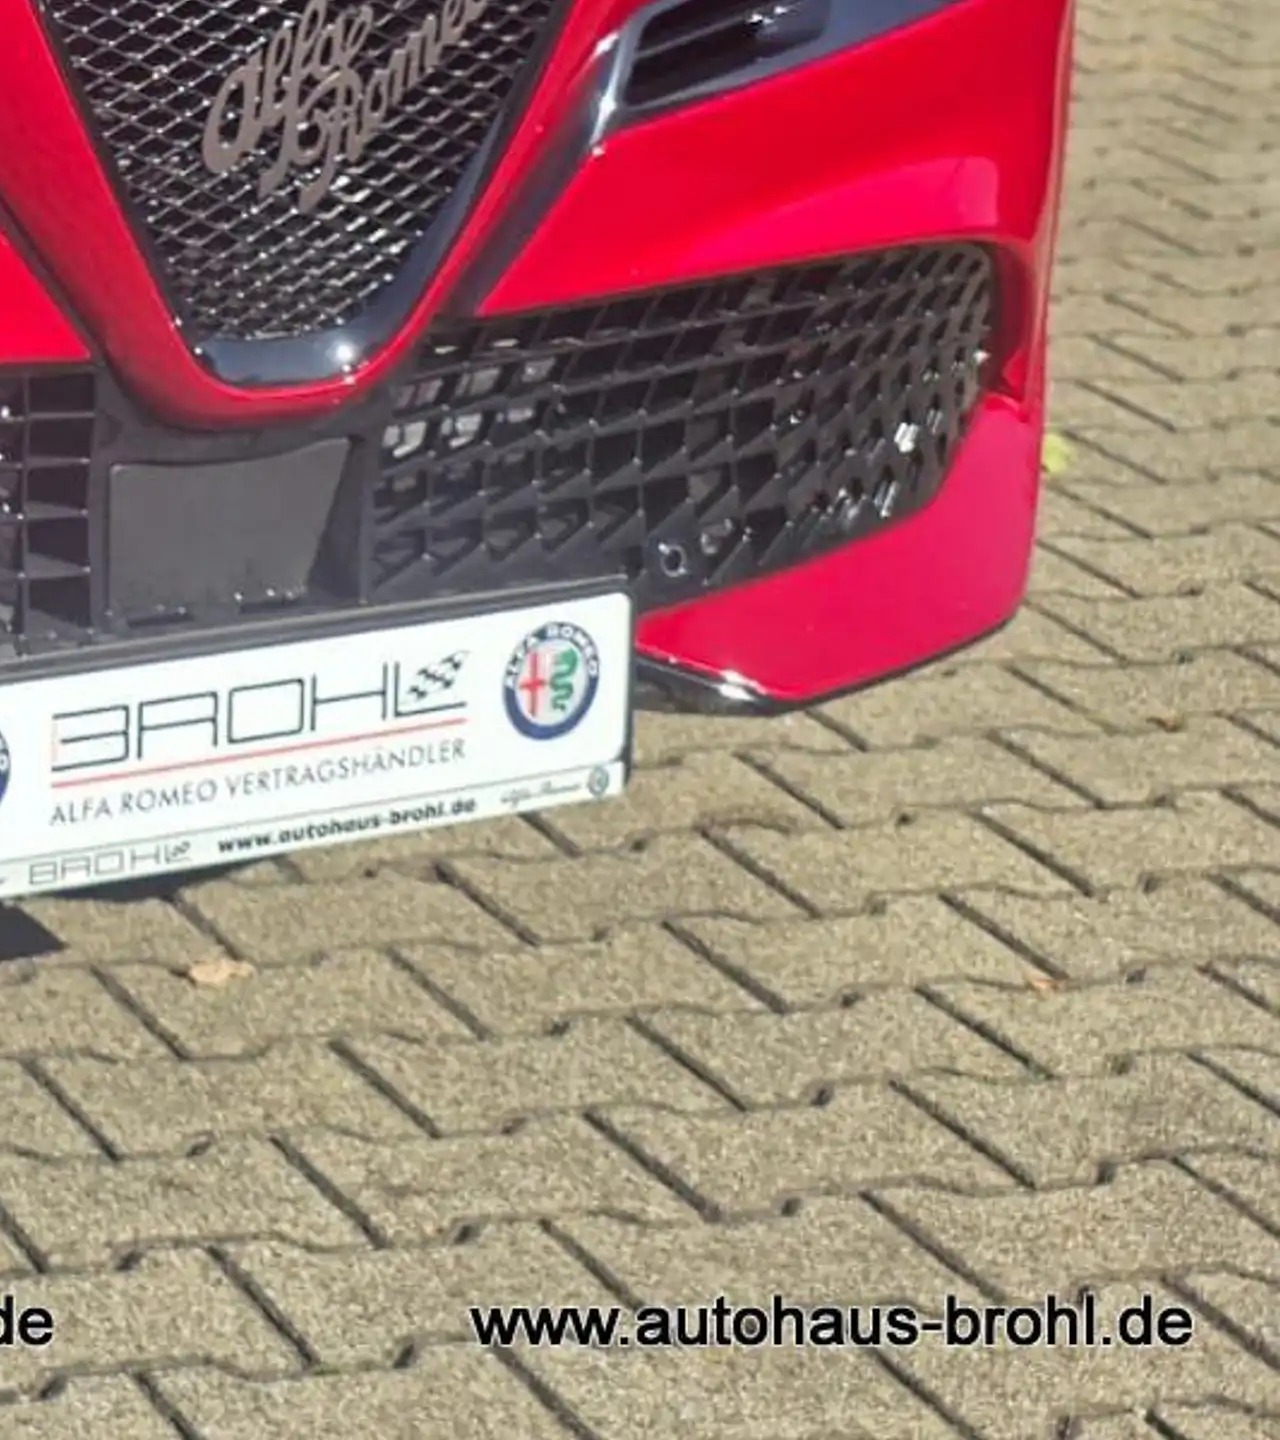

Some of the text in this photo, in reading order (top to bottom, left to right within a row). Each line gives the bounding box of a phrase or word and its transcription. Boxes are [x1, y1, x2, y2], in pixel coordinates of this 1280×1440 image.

[50, 660, 467, 773] BROHL
[49, 795, 114, 827] ALFA
[121, 780, 218, 814] ROMEO
[227, 737, 467, 798] VERTRAGSHÄNDLER
[28, 797, 477, 886] BROHL www.autohaus-brohl.de
